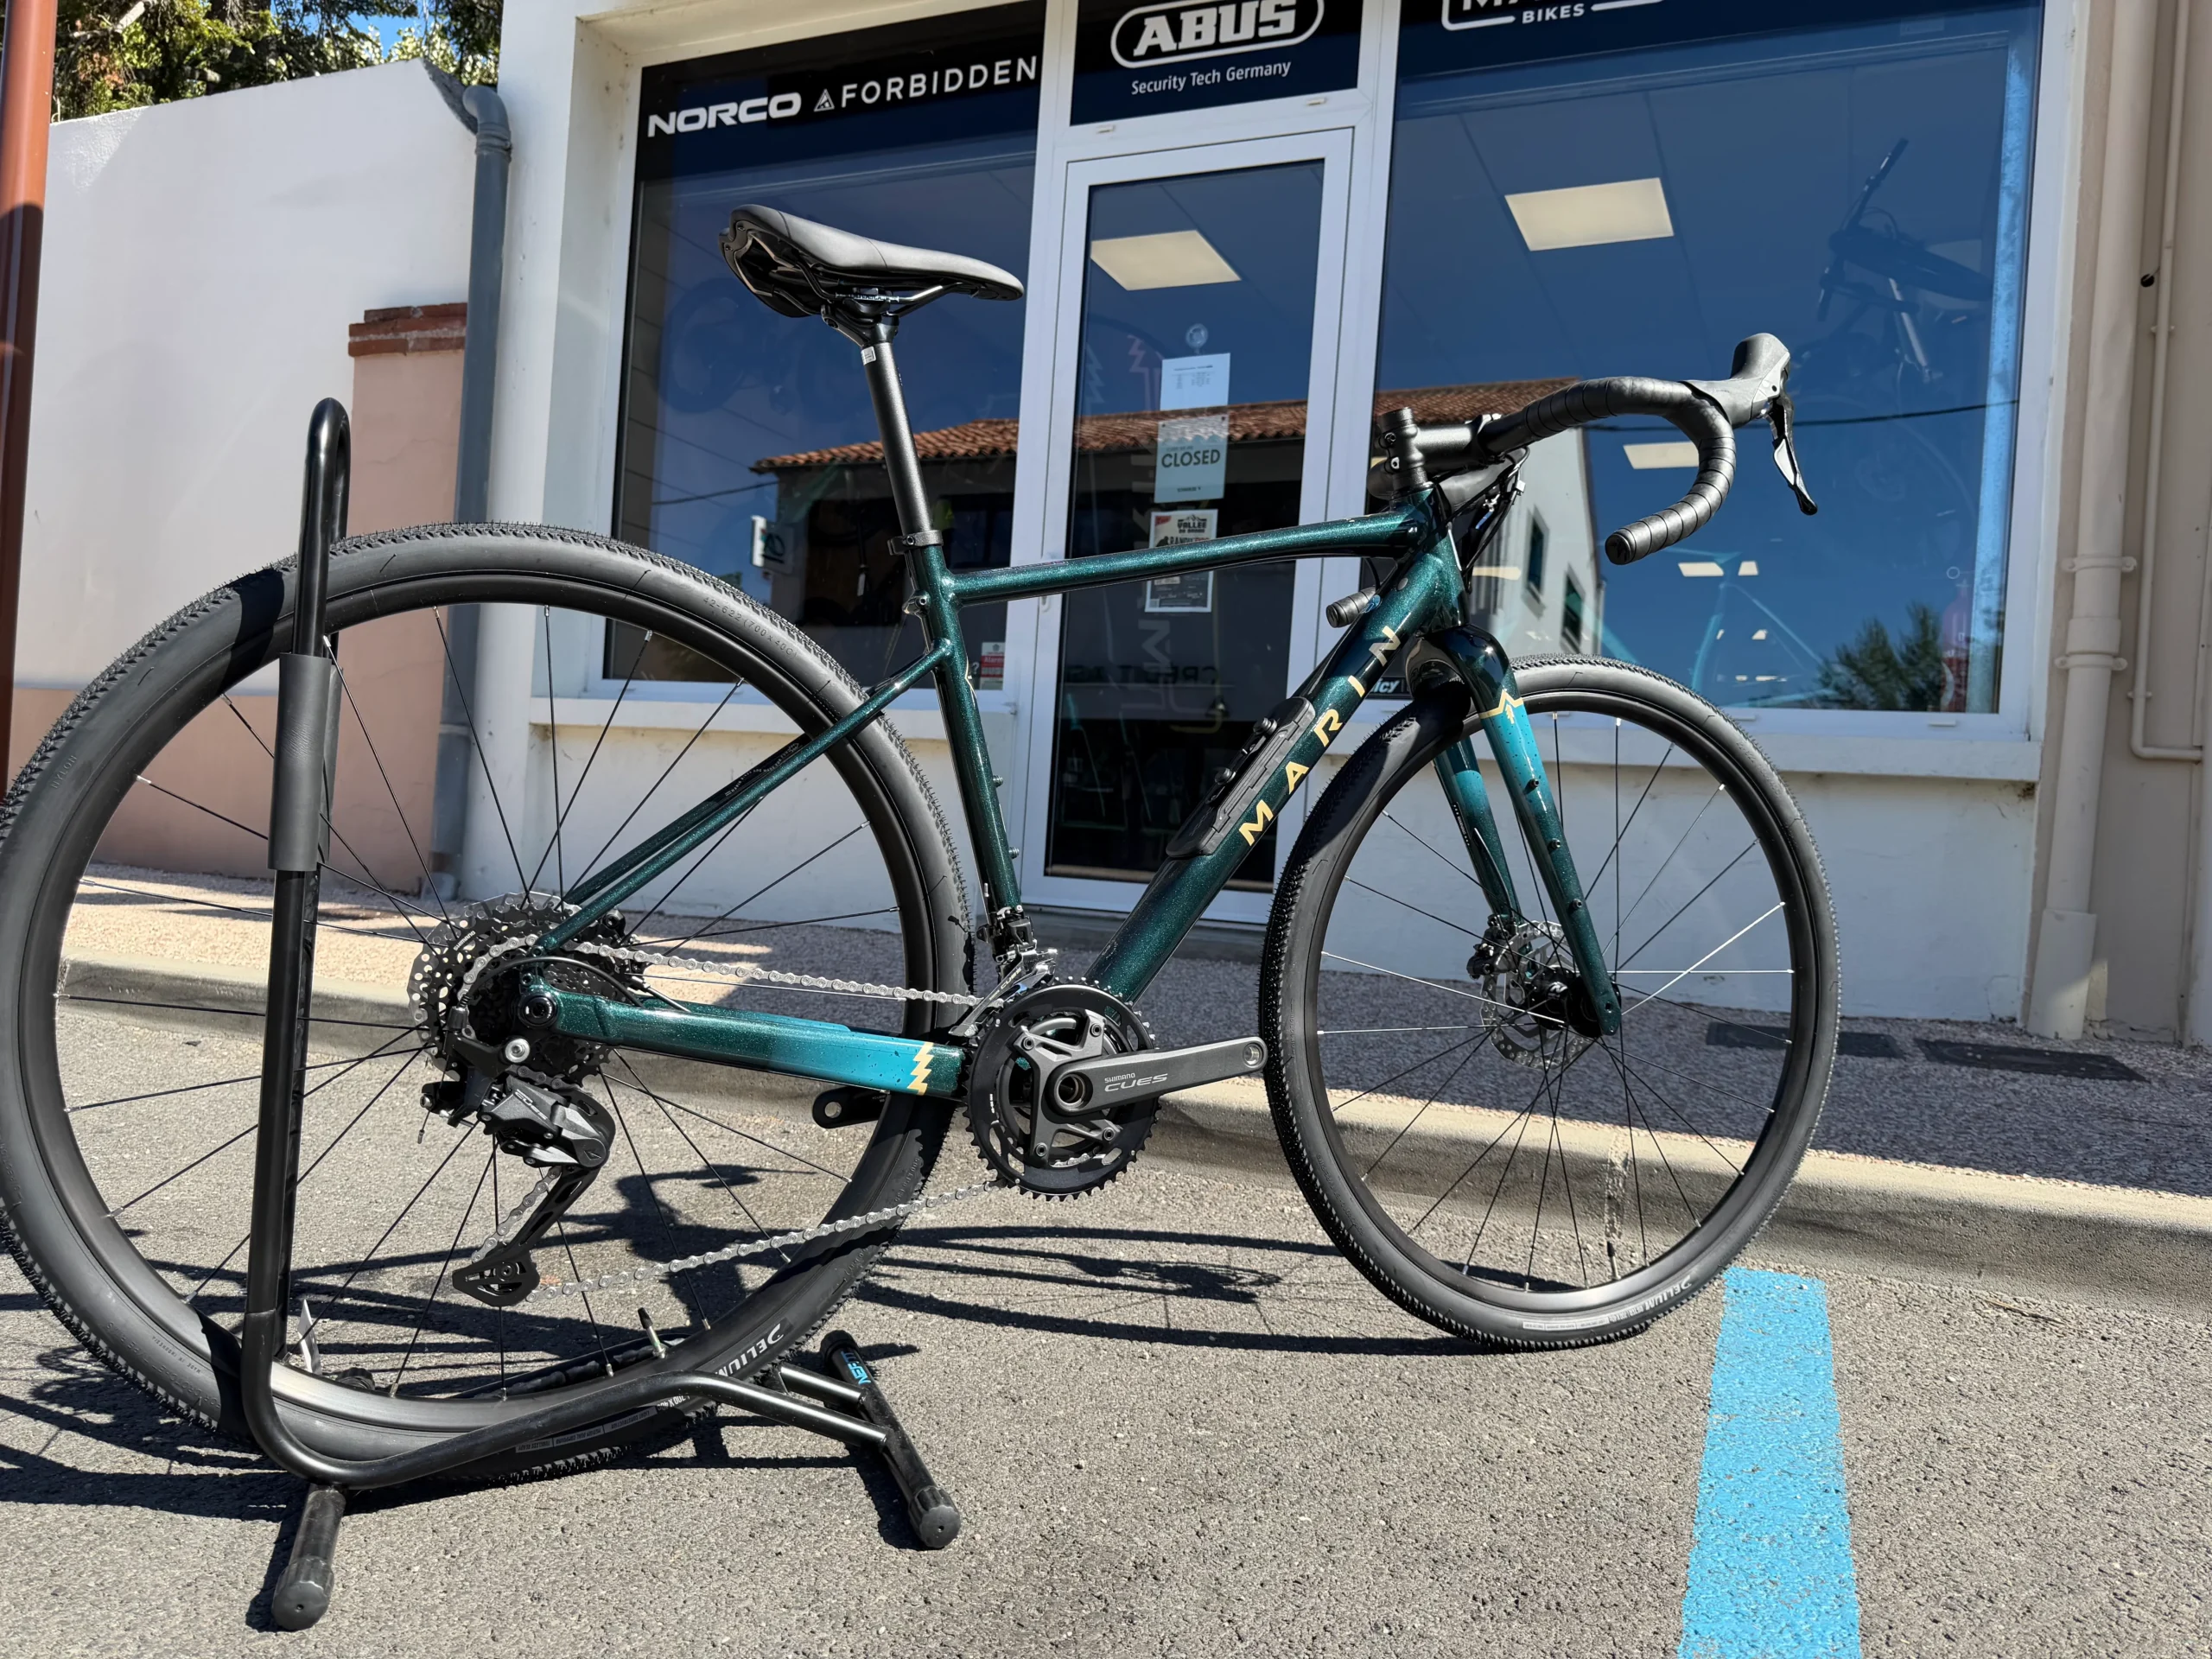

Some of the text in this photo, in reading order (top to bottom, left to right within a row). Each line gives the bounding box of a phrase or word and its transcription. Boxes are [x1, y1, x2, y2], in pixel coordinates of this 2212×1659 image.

[1133, 0, 1297, 56] ABUS
[1522, 3, 1585, 24] BIKES
[841, 55, 1037, 108] FORBIDDEN
[1131, 59, 1292, 95] Security Tech Germany
[647, 92, 801, 137] NORCO
[1161, 448, 1220, 468] CLOSED
[1373, 677, 1401, 694] icy
[1238, 626, 1402, 847] MARIN
[1104, 1072, 1136, 1084] SHIMANO
[1104, 1073, 1168, 1093] CUES
[1644, 1274, 1693, 1311] DELIUM
